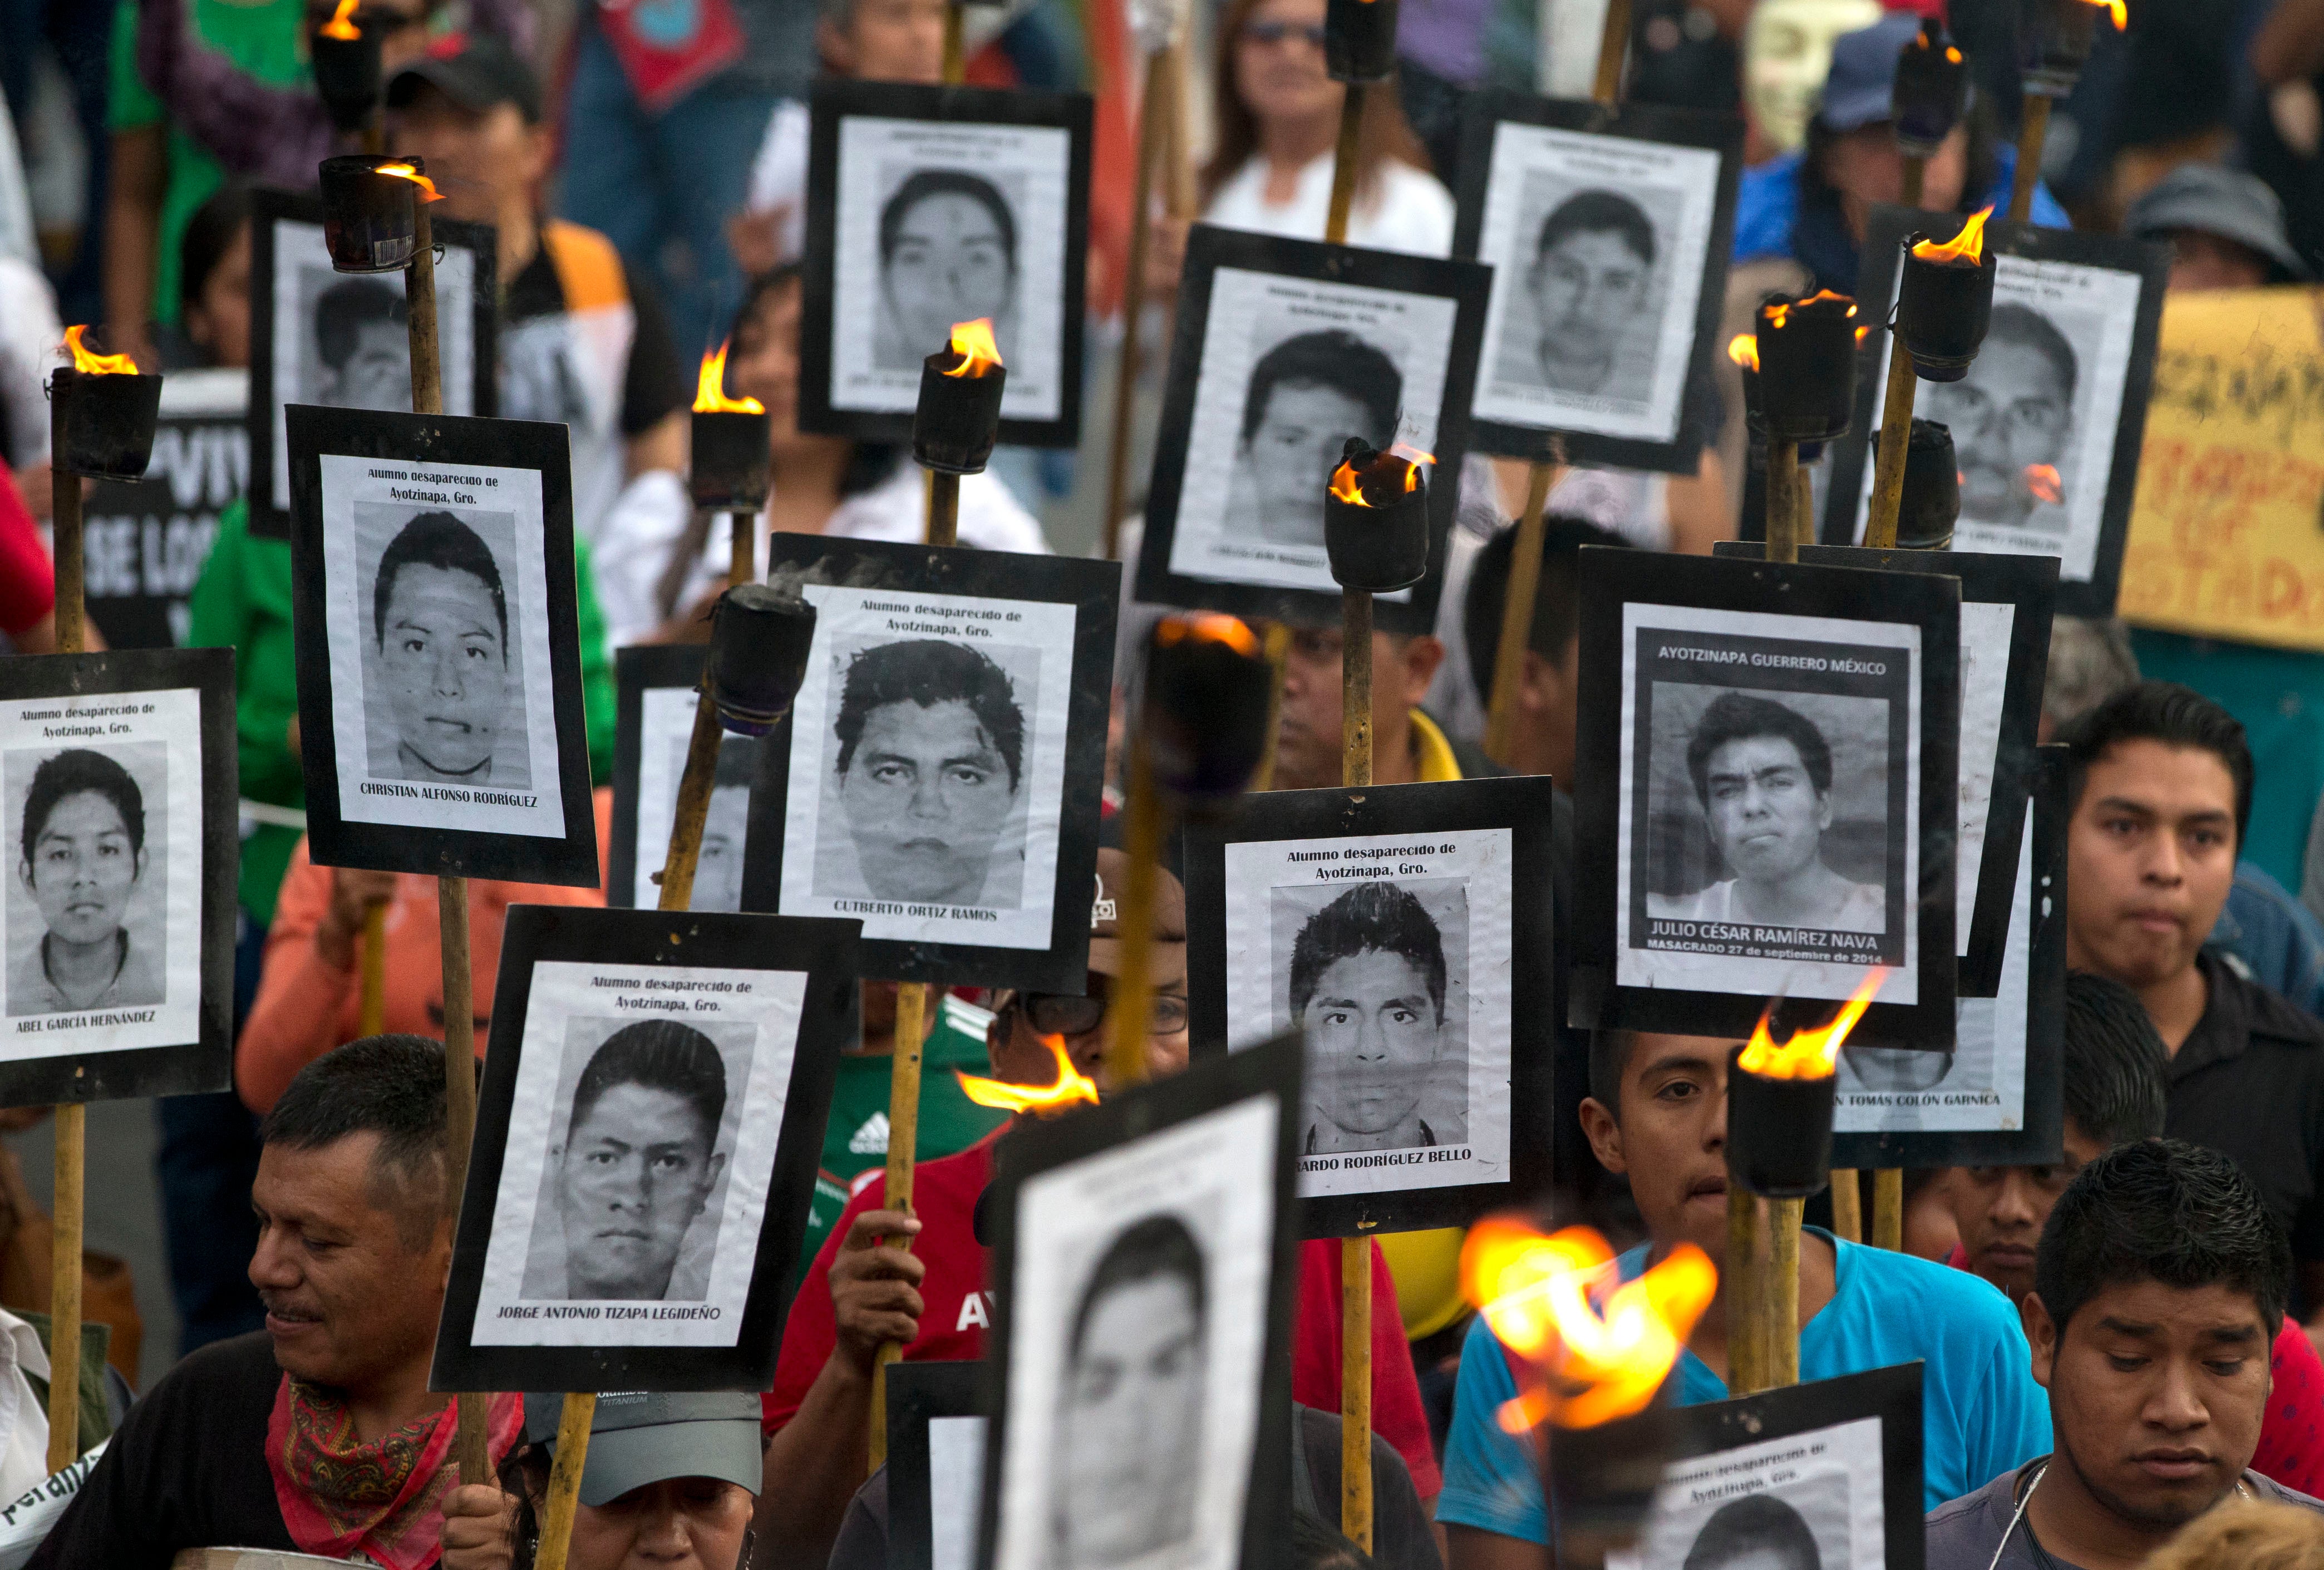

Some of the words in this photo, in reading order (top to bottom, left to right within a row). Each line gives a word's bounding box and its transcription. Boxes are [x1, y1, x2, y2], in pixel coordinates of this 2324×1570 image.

[368, 469, 407, 480] Alumno
[411, 471, 482, 486] desaparecido
[485, 477, 499, 487] de
[390, 487, 450, 504] Ayotzinapa,
[454, 491, 477, 504] Gro.
[860, 599, 910, 613] Alumno
[914, 604, 1002, 621] desaparecido
[1006, 612, 1022, 622] de
[886, 619, 961, 636] Ayotzinapa,
[965, 625, 993, 637] Gro.
[1658, 646, 1749, 665] AYOTZINAPA
[1751, 653, 1828, 672] GUERRERO
[1830, 657, 1887, 676] MÉXICO
[20, 710, 62, 721] Alumno
[65, 705, 139, 719] desaparecido
[141, 703, 156, 714] de
[42, 724, 106, 740] Ayotzinapa,
[109, 724, 132, 734] Gro.
[360, 782, 418, 798] CHRISTIAN
[421, 787, 470, 803] ALFONSO
[474, 791, 538, 808] RODRÍGUEZ
[1287, 851, 1339, 862] Alumno
[1343, 845, 1435, 860] desaparecido
[1440, 844, 1456, 854] de
[1316, 865, 1394, 882] Ayotzinapa,
[1399, 863, 1427, 874] Gro.
[834, 899, 903, 916] CUTBERTO
[907, 904, 947, 918] ORTIZ
[951, 907, 998, 922] RAMOS
[1651, 921, 1697, 937] JULIO
[1700, 923, 1751, 941] CÉSAR
[1755, 927, 1828, 947] RAMÍREZ
[1830, 933, 1878, 950] NAVA
[1647, 939, 1725, 954] MASACRADO
[1728, 945, 1744, 954] 27
[1746, 947, 1762, 956] de
[1764, 949, 1831, 962] septiembre
[1833, 952, 1850, 962] de
[1852, 953, 1883, 964] 2014
[591, 977, 641, 988] Alumno
[645, 979, 732, 993] desaparecido
[736, 983, 752, 993] de
[615, 996, 690, 1012] Ayotzinapa,
[694, 998, 721, 1011] Gro.
[16, 1020, 43, 1033] ABEL
[47, 1016, 87, 1031] GARCÍA
[90, 1010, 156, 1027] HERNÁNDEZ
[1849, 1094, 1893, 1106] TOMÁS
[1896, 1094, 1941, 1106] COLÓN
[1944, 1094, 2001, 1106] GARNICA
[1296, 1158, 1340, 1173] RARDO
[1344, 1152, 1424, 1169] RODRÍGUEZ
[1429, 1149, 1472, 1163] BELLO
[496, 1306, 540, 1319] JORGE
[542, 1307, 600, 1320] ANTONIO
[604, 1307, 648, 1320] TIZAPA
[652, 1305, 721, 1321] LEGIDEÑO
[601, 1395, 648, 1407] TITANIUM
